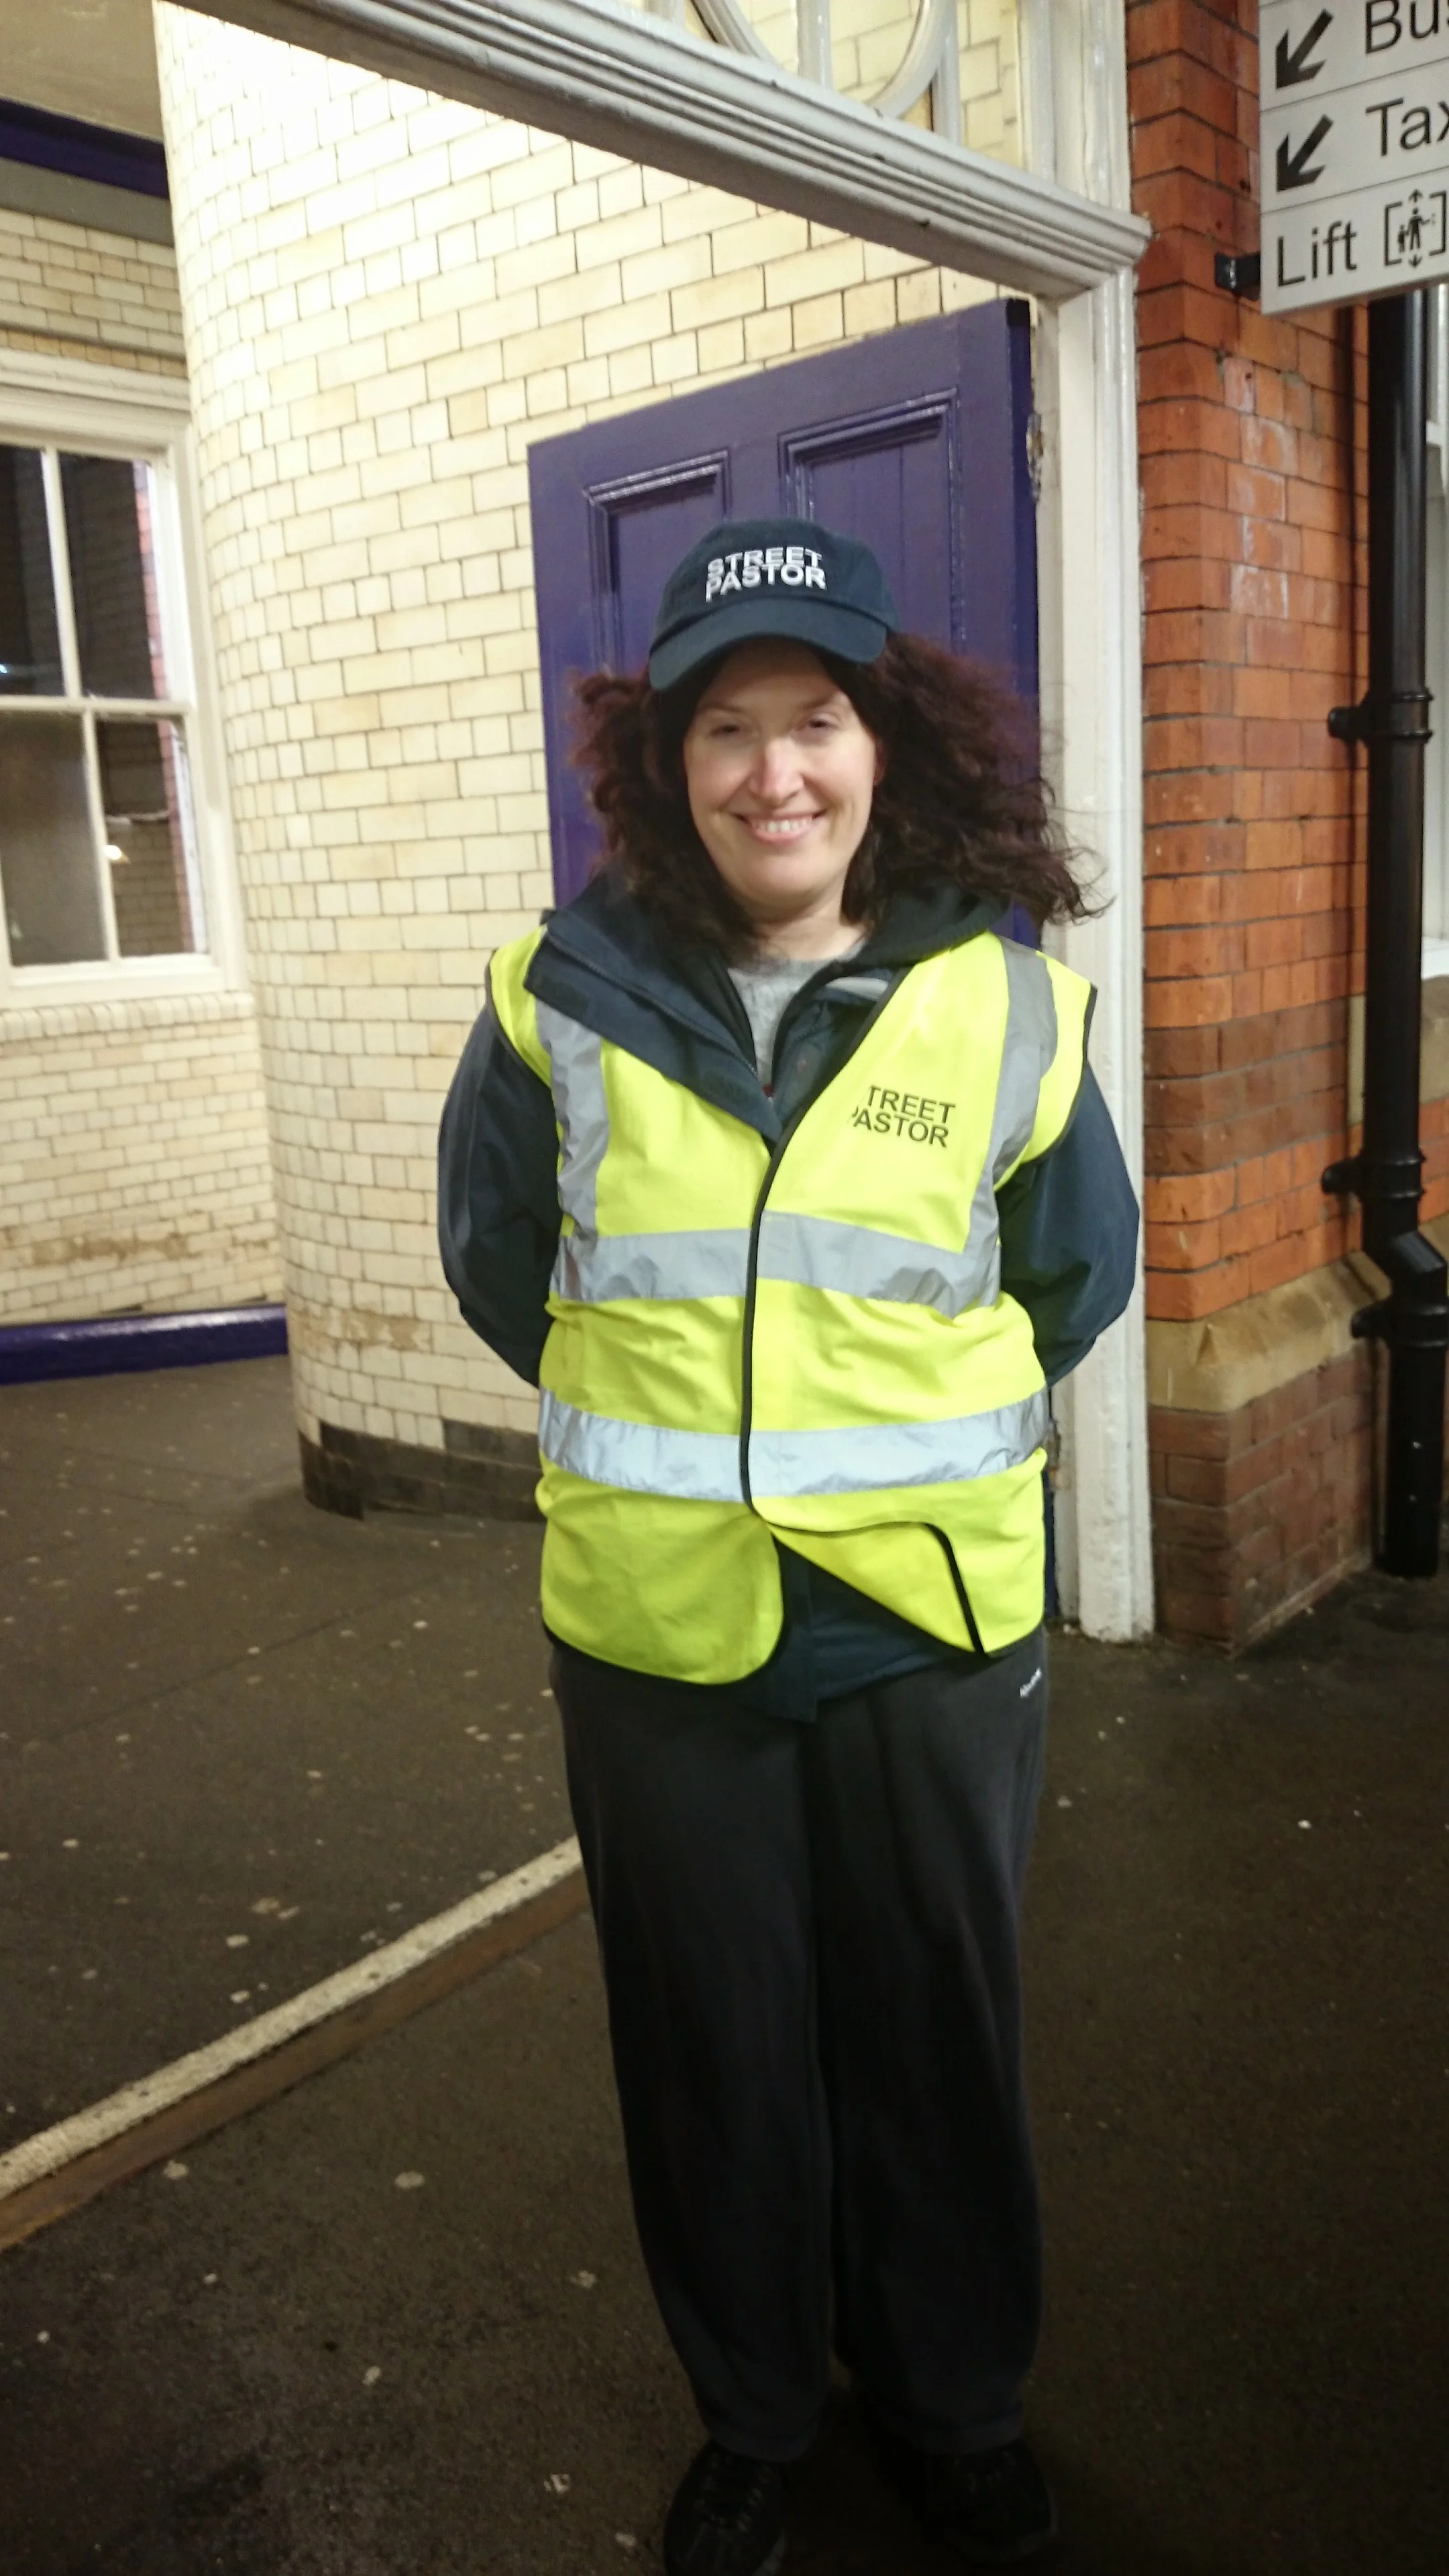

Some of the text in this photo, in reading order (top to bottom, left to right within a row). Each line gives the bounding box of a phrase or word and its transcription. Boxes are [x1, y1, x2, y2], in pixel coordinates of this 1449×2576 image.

[1365, 0, 1449, 54] Bu
[1277, 220, 1358, 287] Lift
[705, 563, 828, 603] PASTOR
[707, 547, 822, 578] STREET
[866, 1084, 956, 1124] TREET
[851, 1106, 949, 1148] ASTOR
